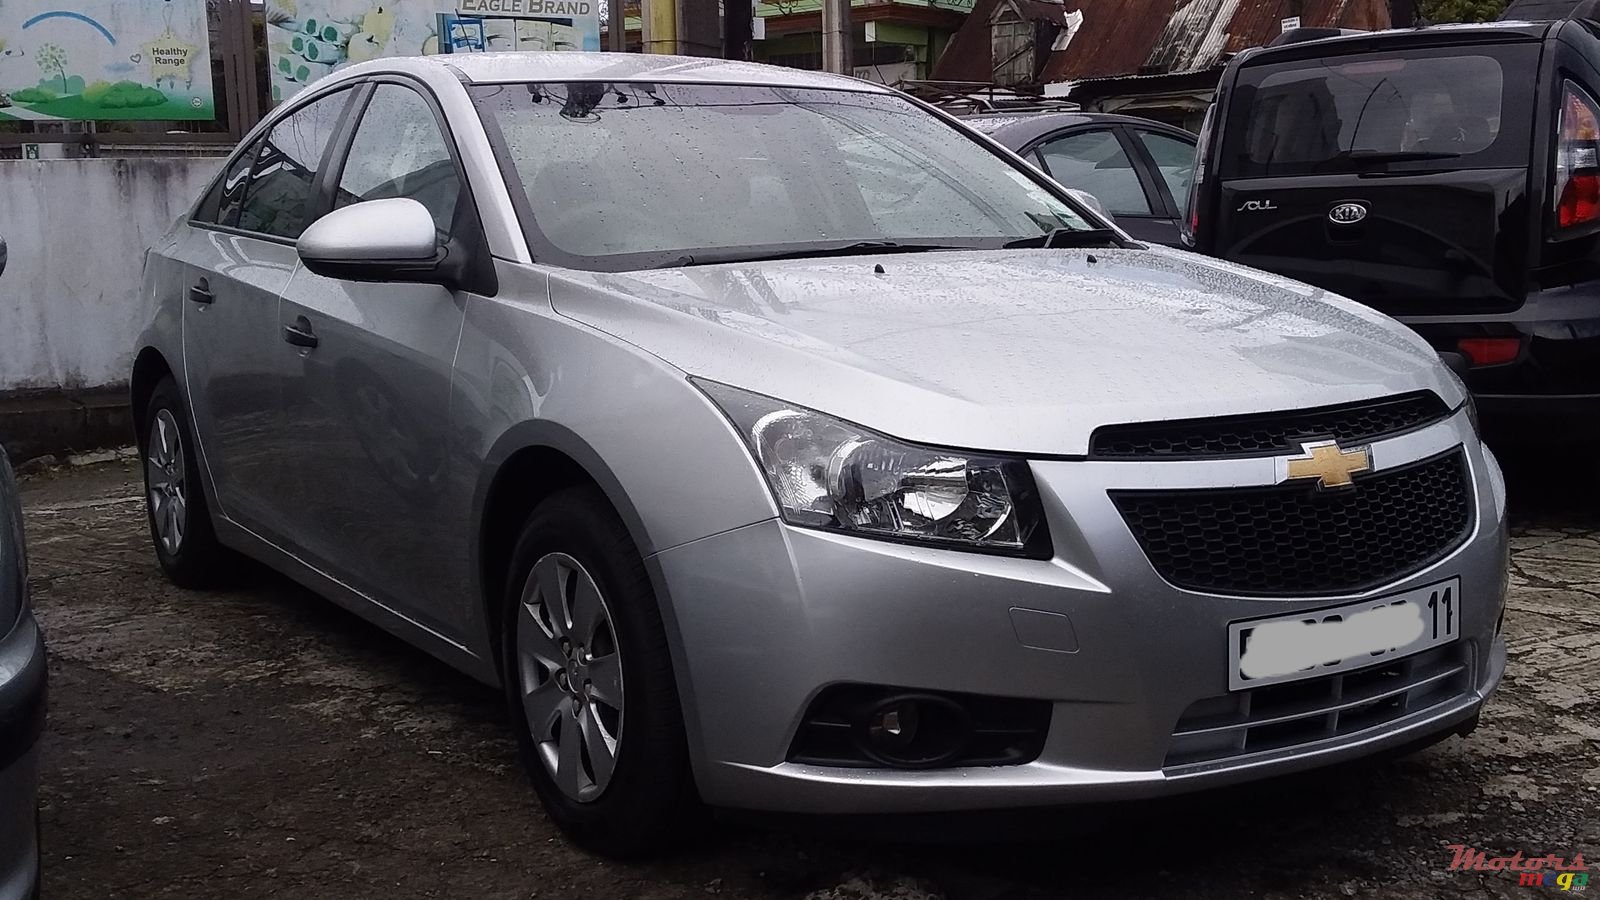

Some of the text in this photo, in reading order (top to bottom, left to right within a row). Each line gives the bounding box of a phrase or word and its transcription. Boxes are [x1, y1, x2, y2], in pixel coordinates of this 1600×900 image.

[462, 0, 591, 15] EAGLE BRAND
[152, 47, 188, 57] Healthy
[155, 57, 185, 66] Range
[1335, 206, 1361, 220] KIA
[1427, 586, 1453, 640] 11
